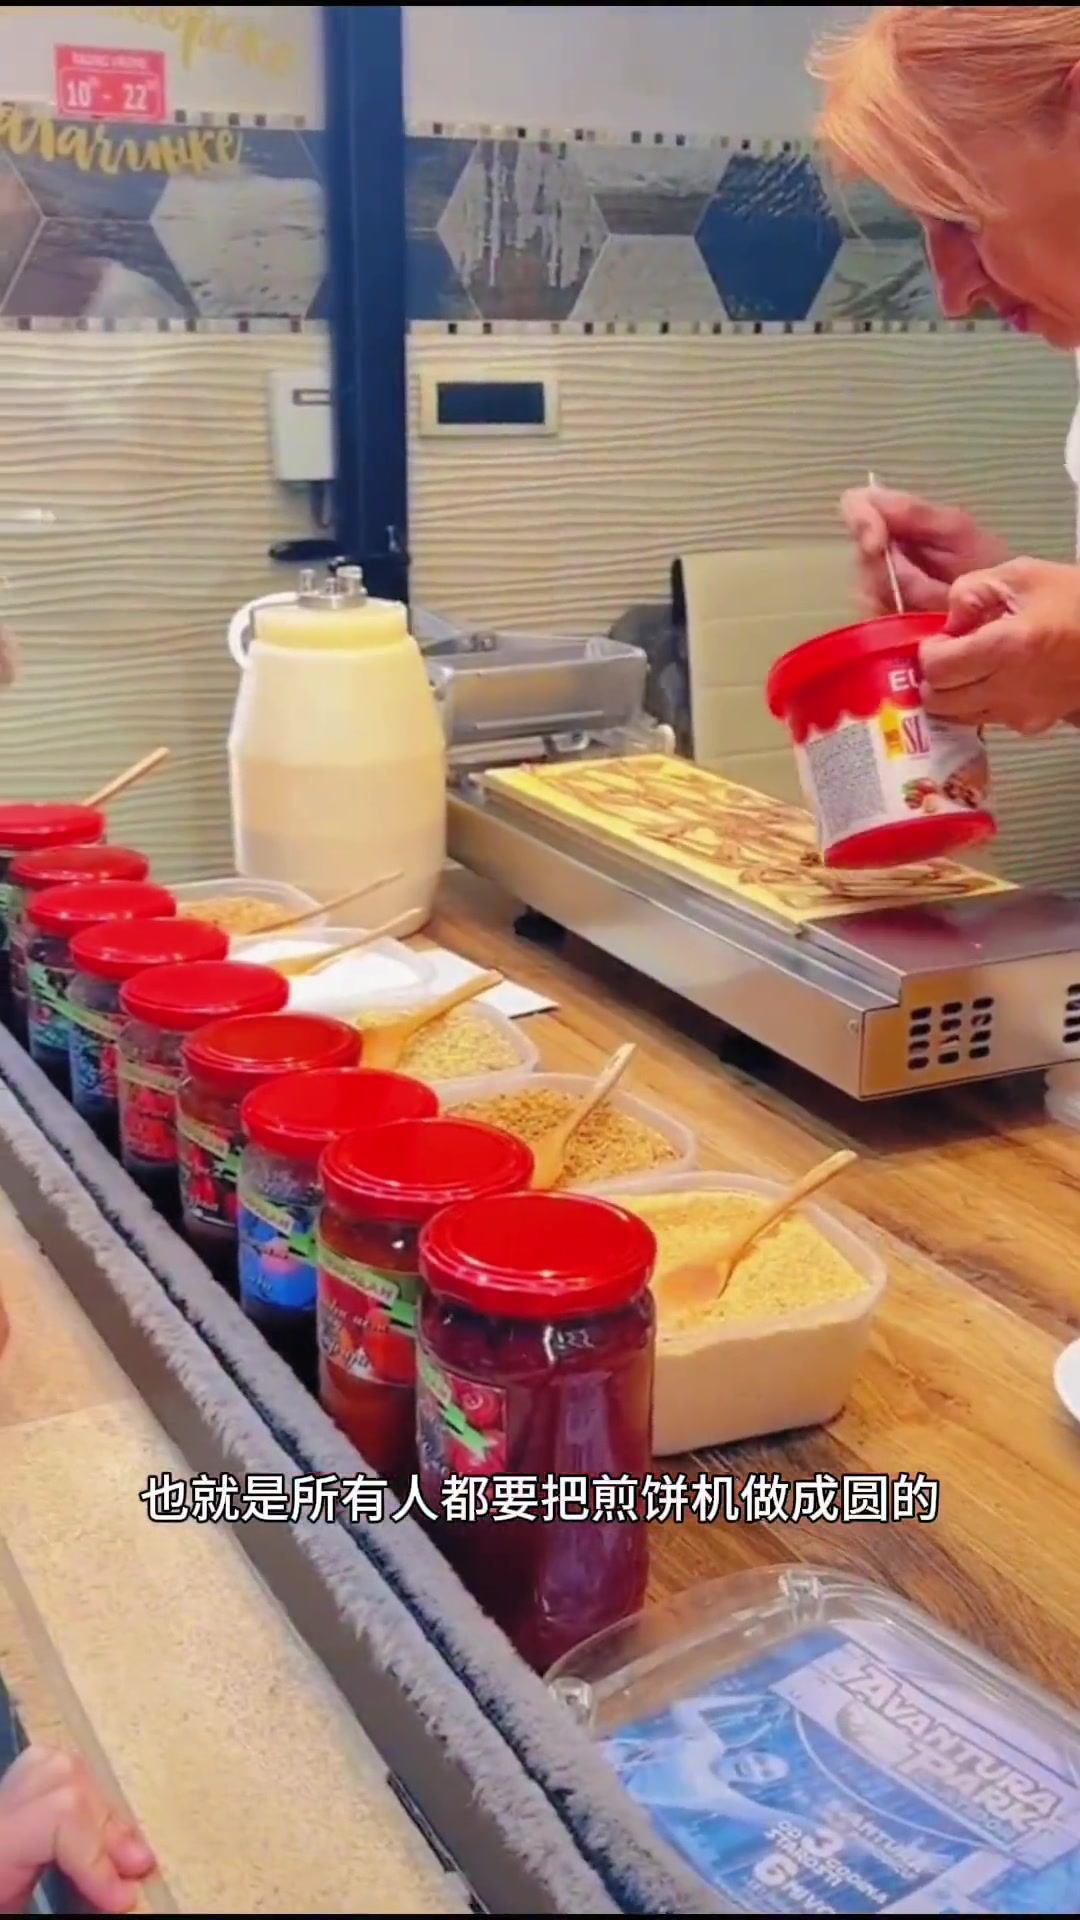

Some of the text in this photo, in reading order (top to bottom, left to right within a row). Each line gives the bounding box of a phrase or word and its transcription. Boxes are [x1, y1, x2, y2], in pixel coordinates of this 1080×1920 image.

[838, 1662, 1064, 1820] AVANTURA
[896, 1742, 1035, 1836] PARK
[754, 1852, 799, 1887] 6
[800, 1827, 845, 1858] 3
